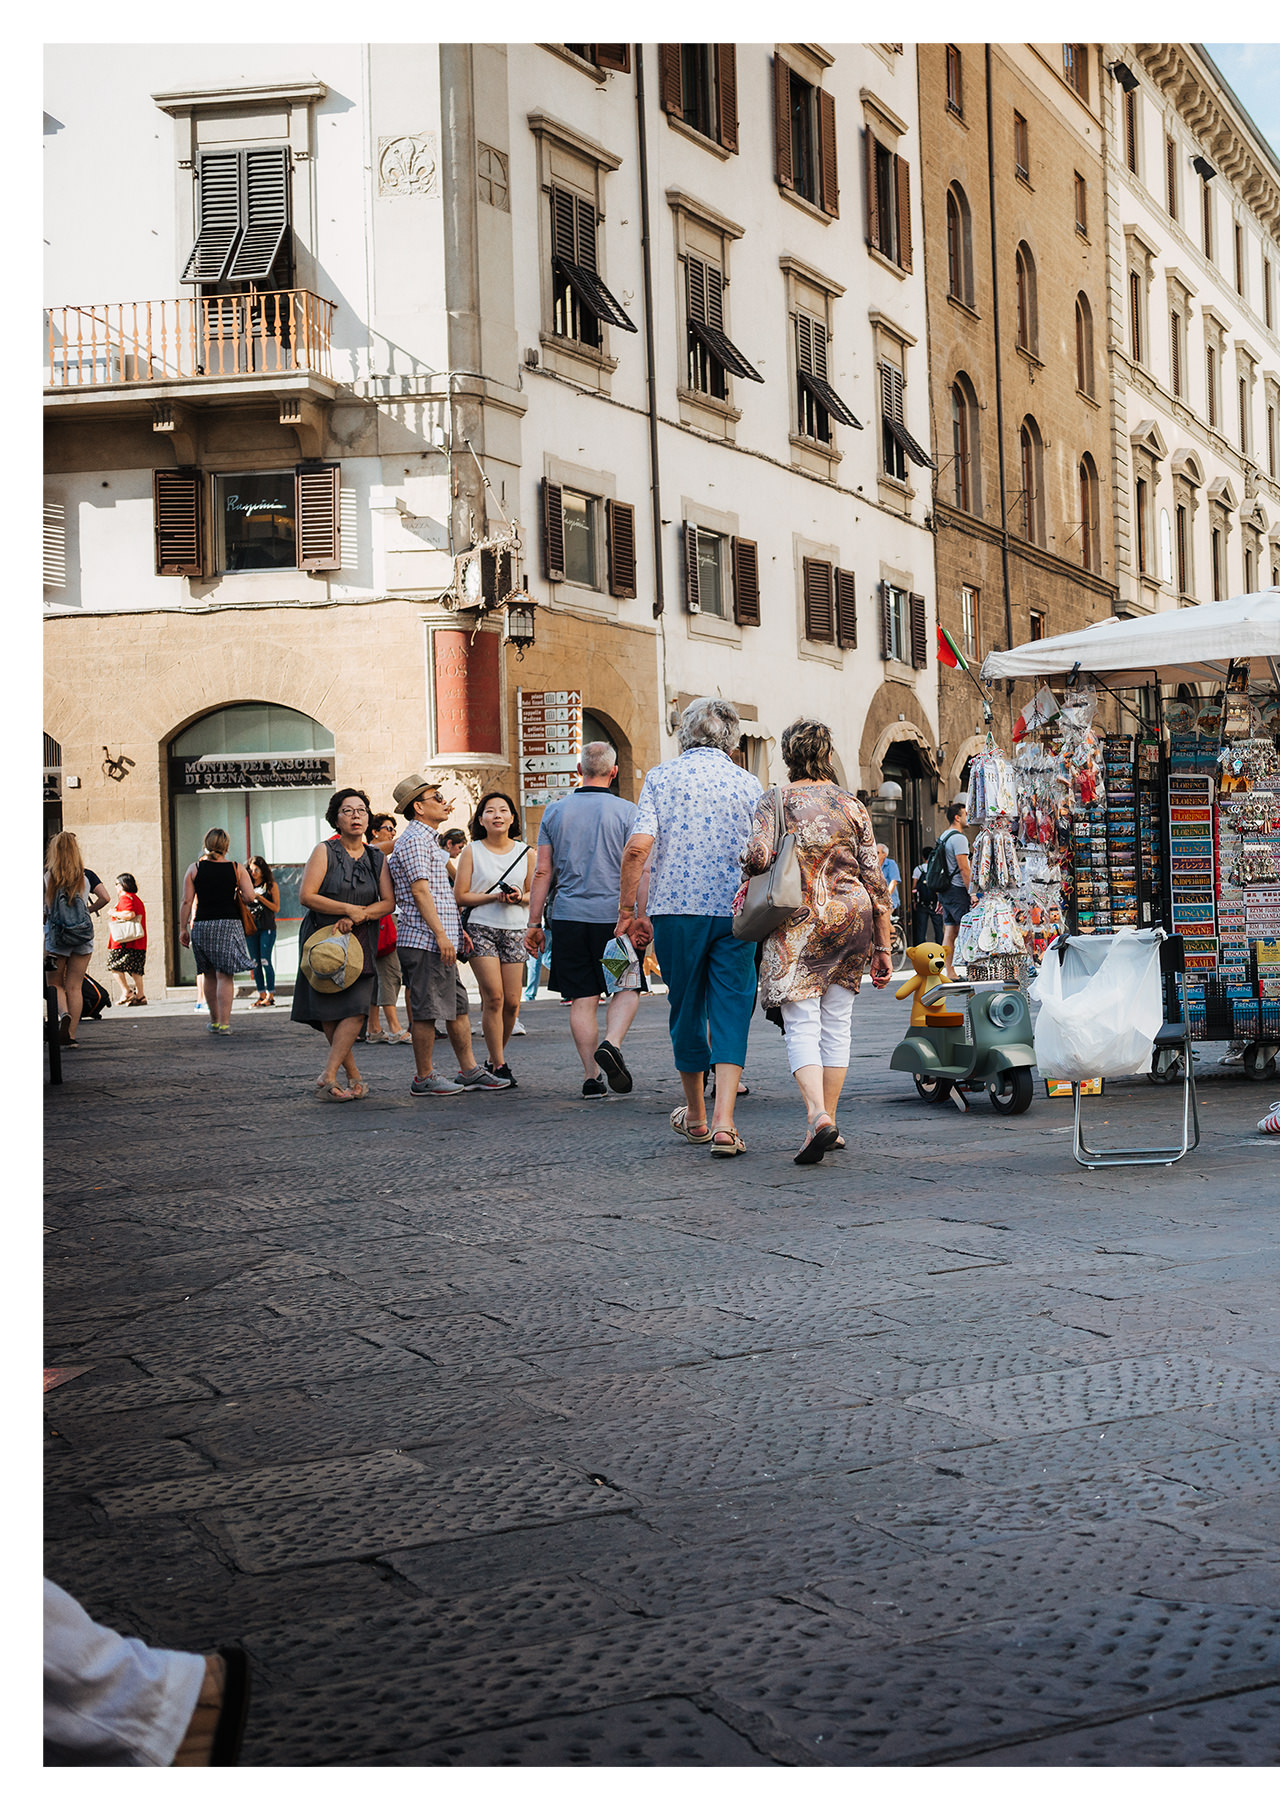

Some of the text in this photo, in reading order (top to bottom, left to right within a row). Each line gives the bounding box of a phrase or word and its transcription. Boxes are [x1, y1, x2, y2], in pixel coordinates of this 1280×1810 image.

[184, 758, 322, 774] MONTE DEI PASCHI
[184, 773, 201, 785] DI
[204, 772, 247, 784] SIENA
[1173, 812, 1209, 820] FLORENCE
[1172, 828, 1209, 836] FLORENCIA
[1173, 862, 1210, 870] フィレンツェ
[1176, 895, 1210, 904] TUSCANY
[1177, 909, 1210, 917] TOSCANA
[1178, 926, 1211, 935] TOSCANE
[1184, 943, 1215, 951] OSCANA
[1184, 959, 1215, 968] ОСКАНА
[1178, 986, 1203, 994] FRENCE
